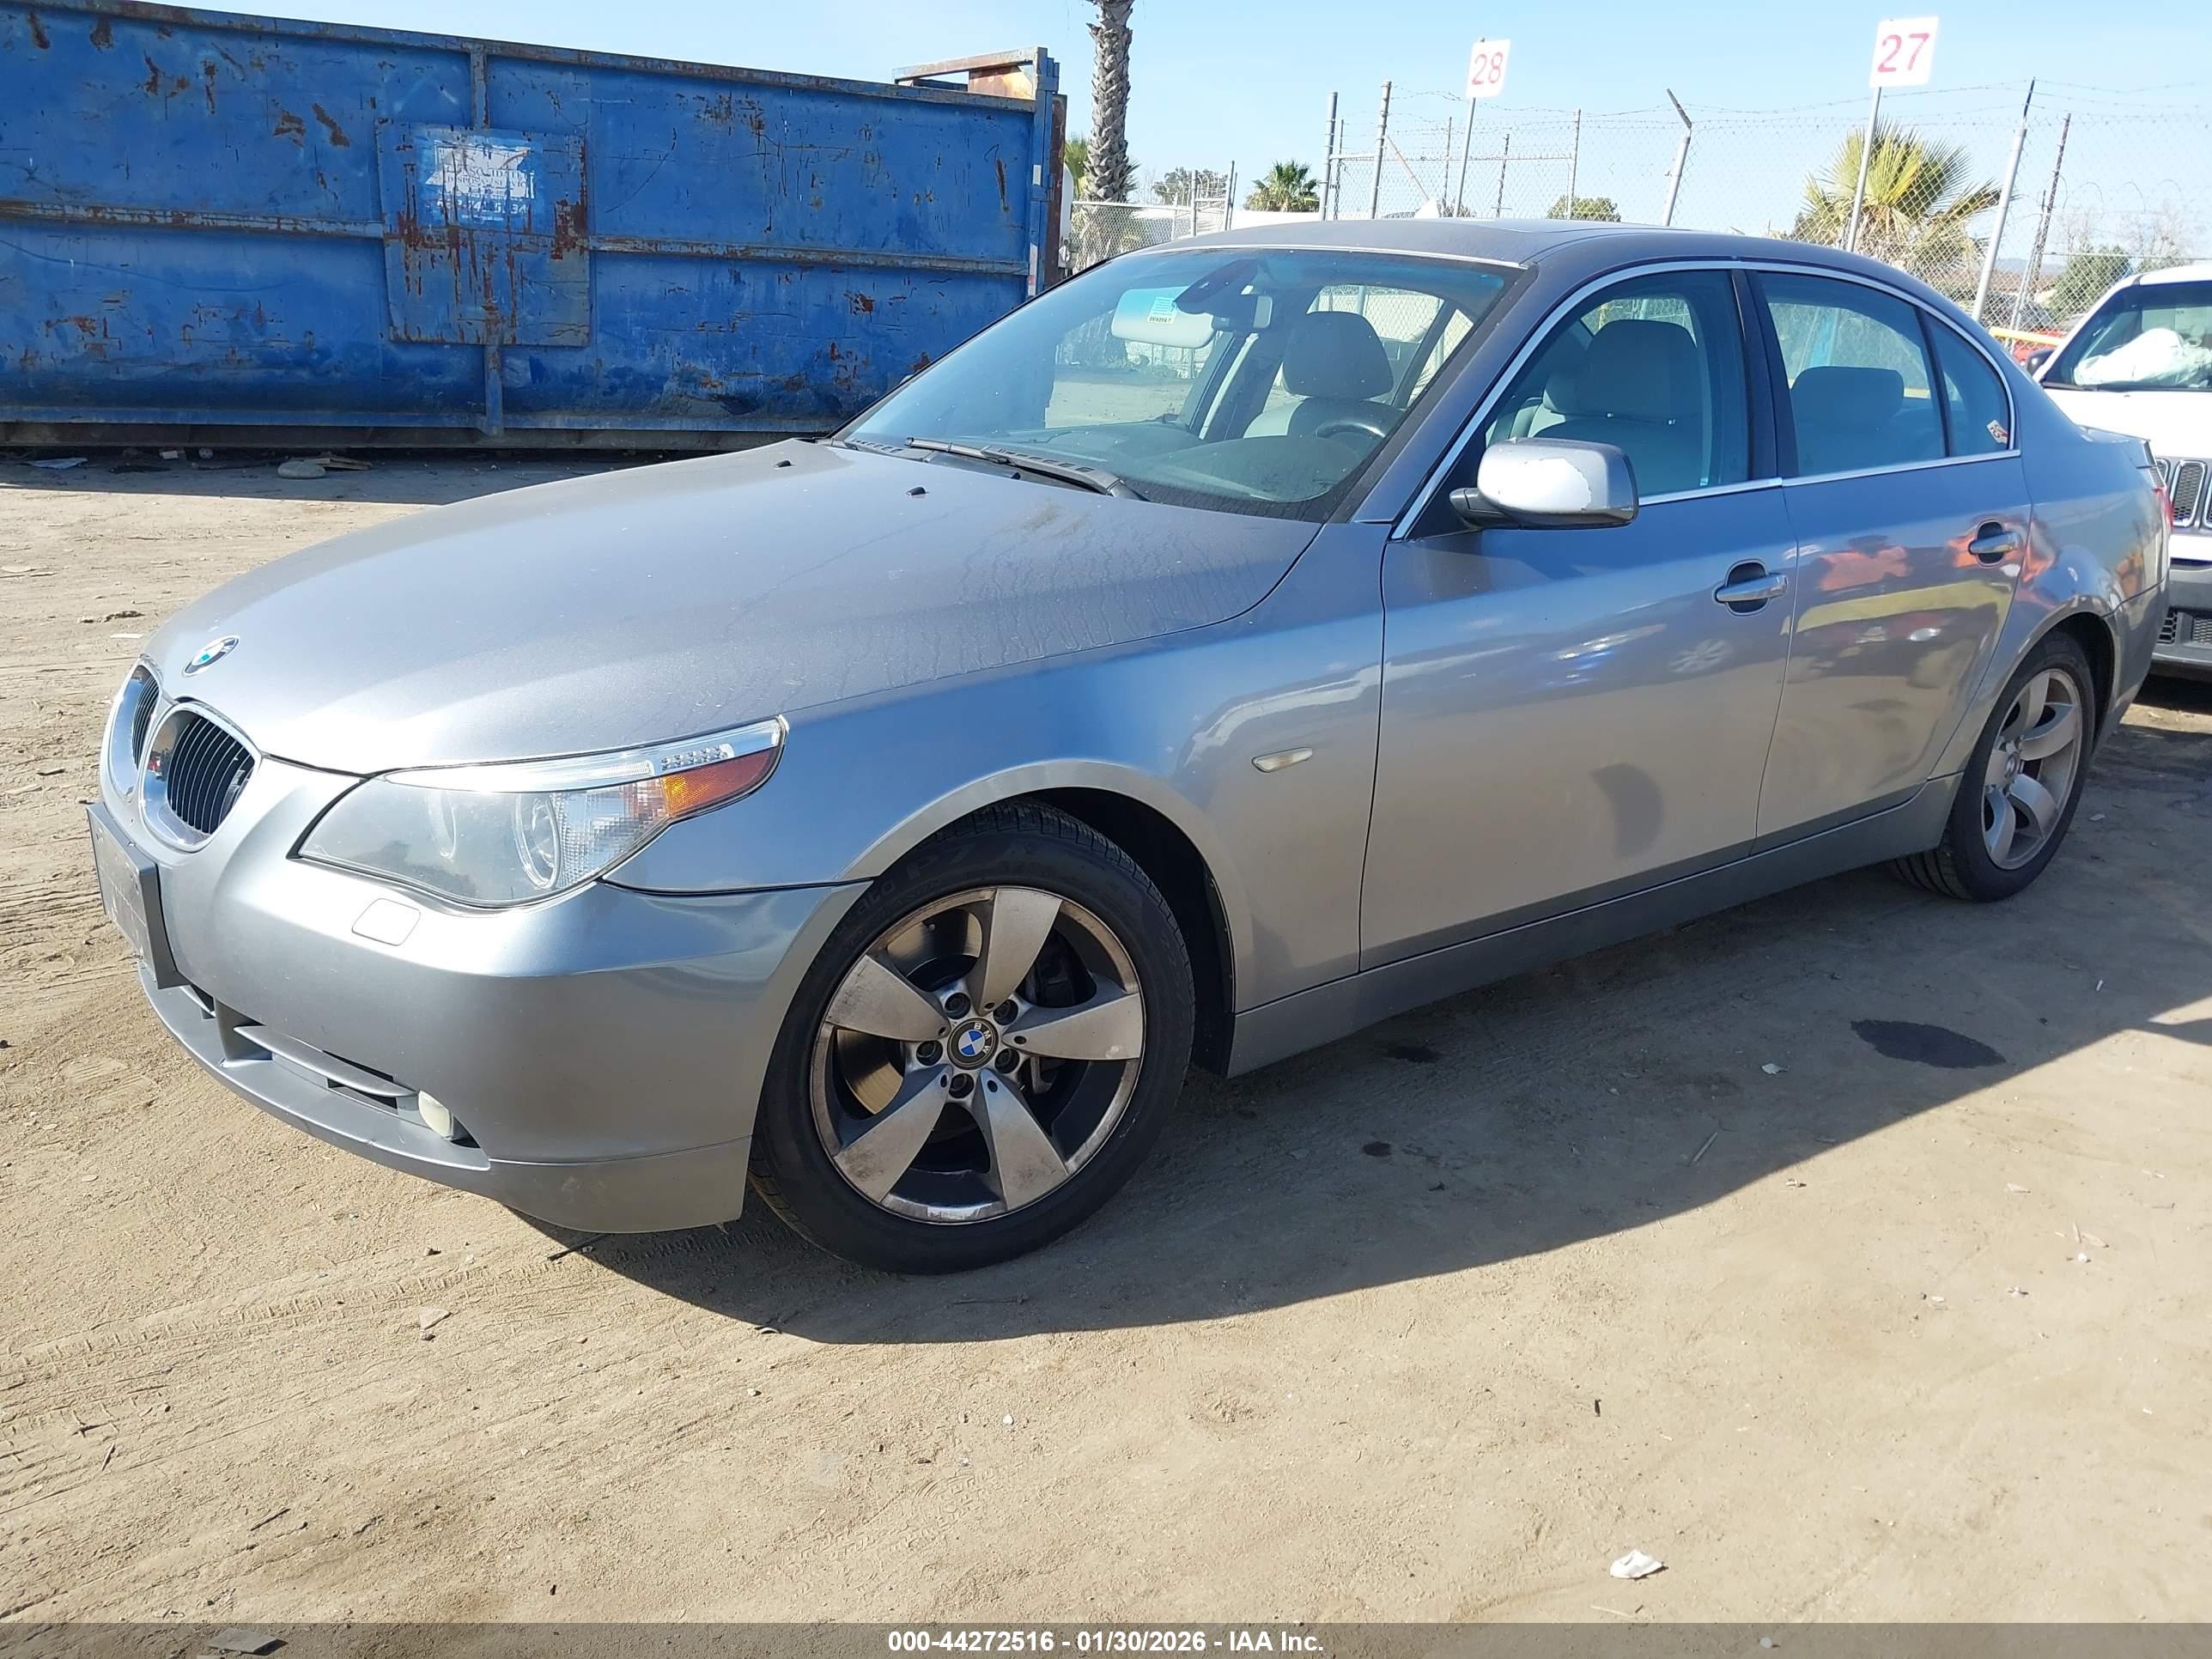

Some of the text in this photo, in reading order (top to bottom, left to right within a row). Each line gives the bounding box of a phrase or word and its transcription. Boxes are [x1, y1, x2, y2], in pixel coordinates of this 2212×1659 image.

[1471, 52, 1504, 85] 28
[1877, 32, 1930, 73] 27
[974, 1022, 992, 1054] BMW
